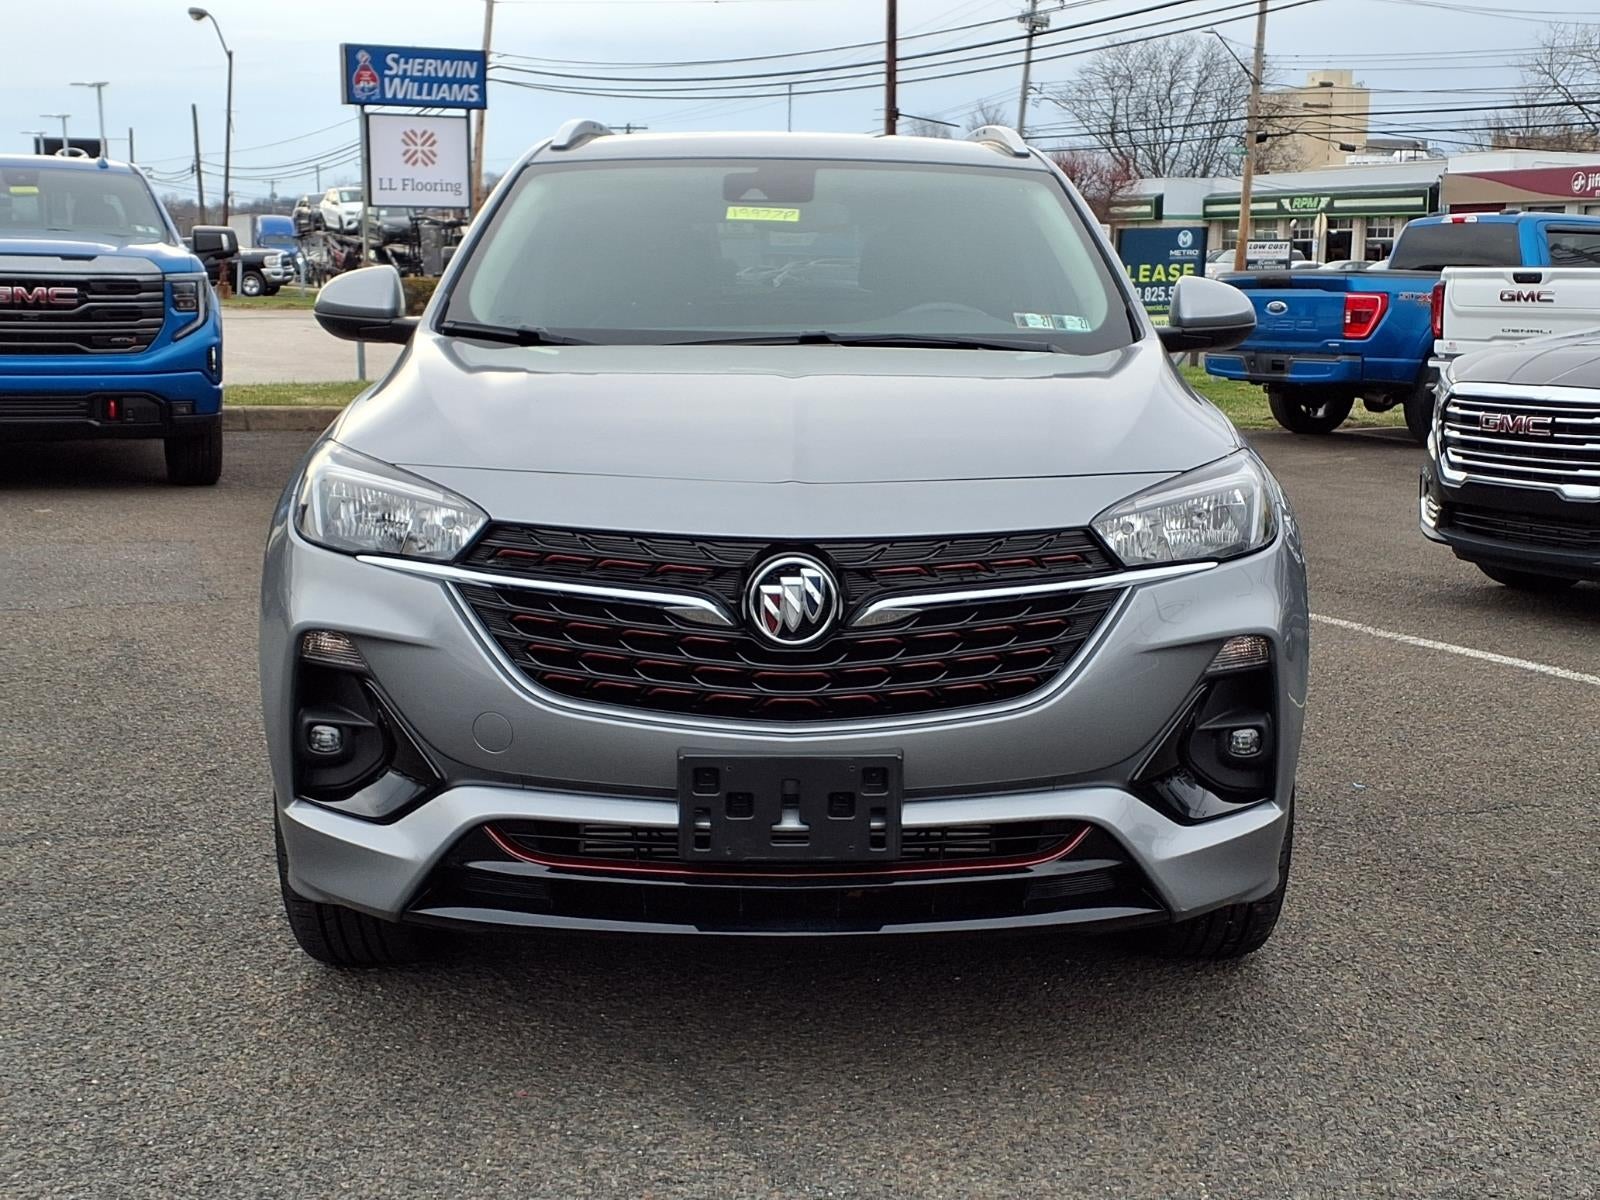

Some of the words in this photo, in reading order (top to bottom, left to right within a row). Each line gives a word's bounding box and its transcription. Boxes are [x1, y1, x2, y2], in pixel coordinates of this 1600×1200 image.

[384, 53, 478, 78] SHERWIN
[384, 77, 480, 102] WILLIAMS
[379, 178, 397, 191] LL
[402, 178, 463, 196] Flooring
[1586, 173, 1600, 191] jif
[1292, 196, 1319, 209] RPM
[1126, 263, 1195, 283] LEASE
[1500, 290, 1555, 303] GMC
[1480, 412, 1553, 436] GMC
